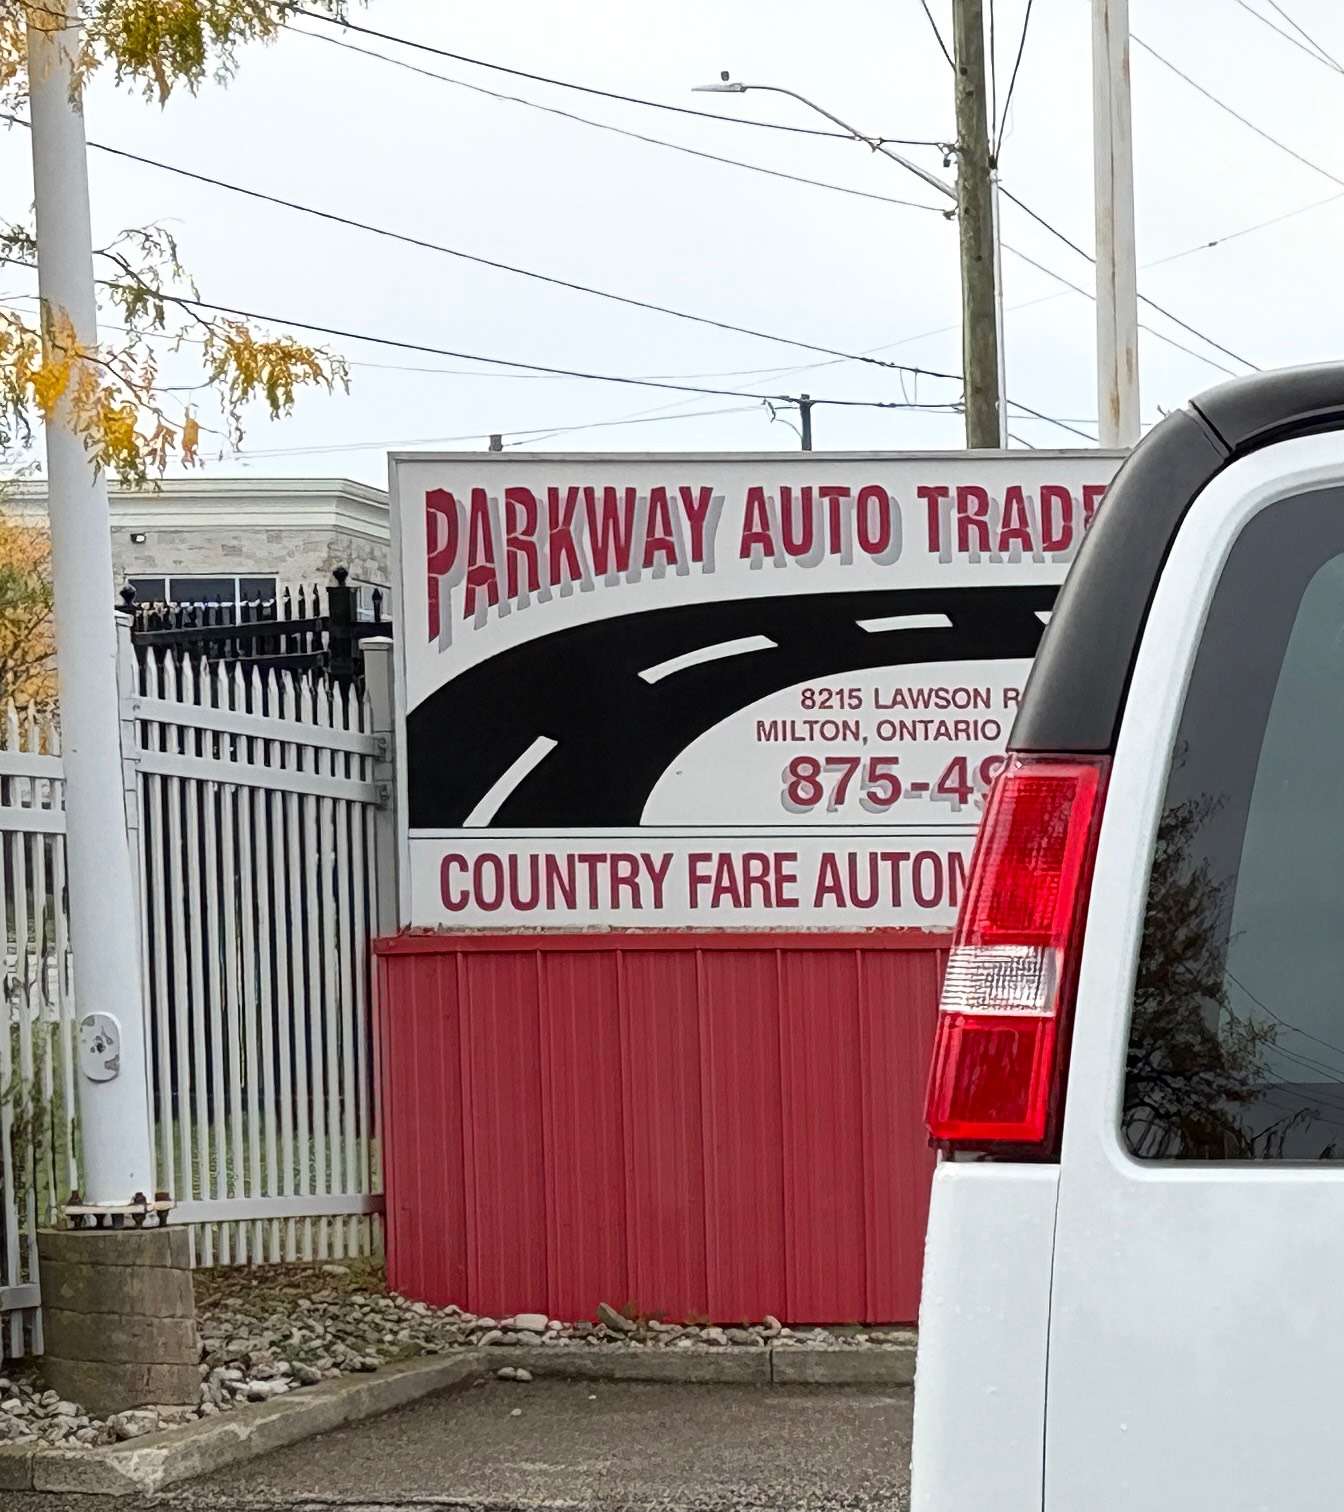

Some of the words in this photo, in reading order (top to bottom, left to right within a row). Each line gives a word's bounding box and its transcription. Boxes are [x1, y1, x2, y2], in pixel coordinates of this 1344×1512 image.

[425, 486, 725, 653] PARKWAY
[739, 485, 903, 570] AUTO
[801, 687, 863, 710] 8215
[874, 687, 991, 710] LAWSON
[756, 719, 868, 746] MILTON,
[876, 719, 1001, 742] ONTARIO
[440, 852, 674, 912] COUNTRY
[688, 851, 800, 909] FARE
